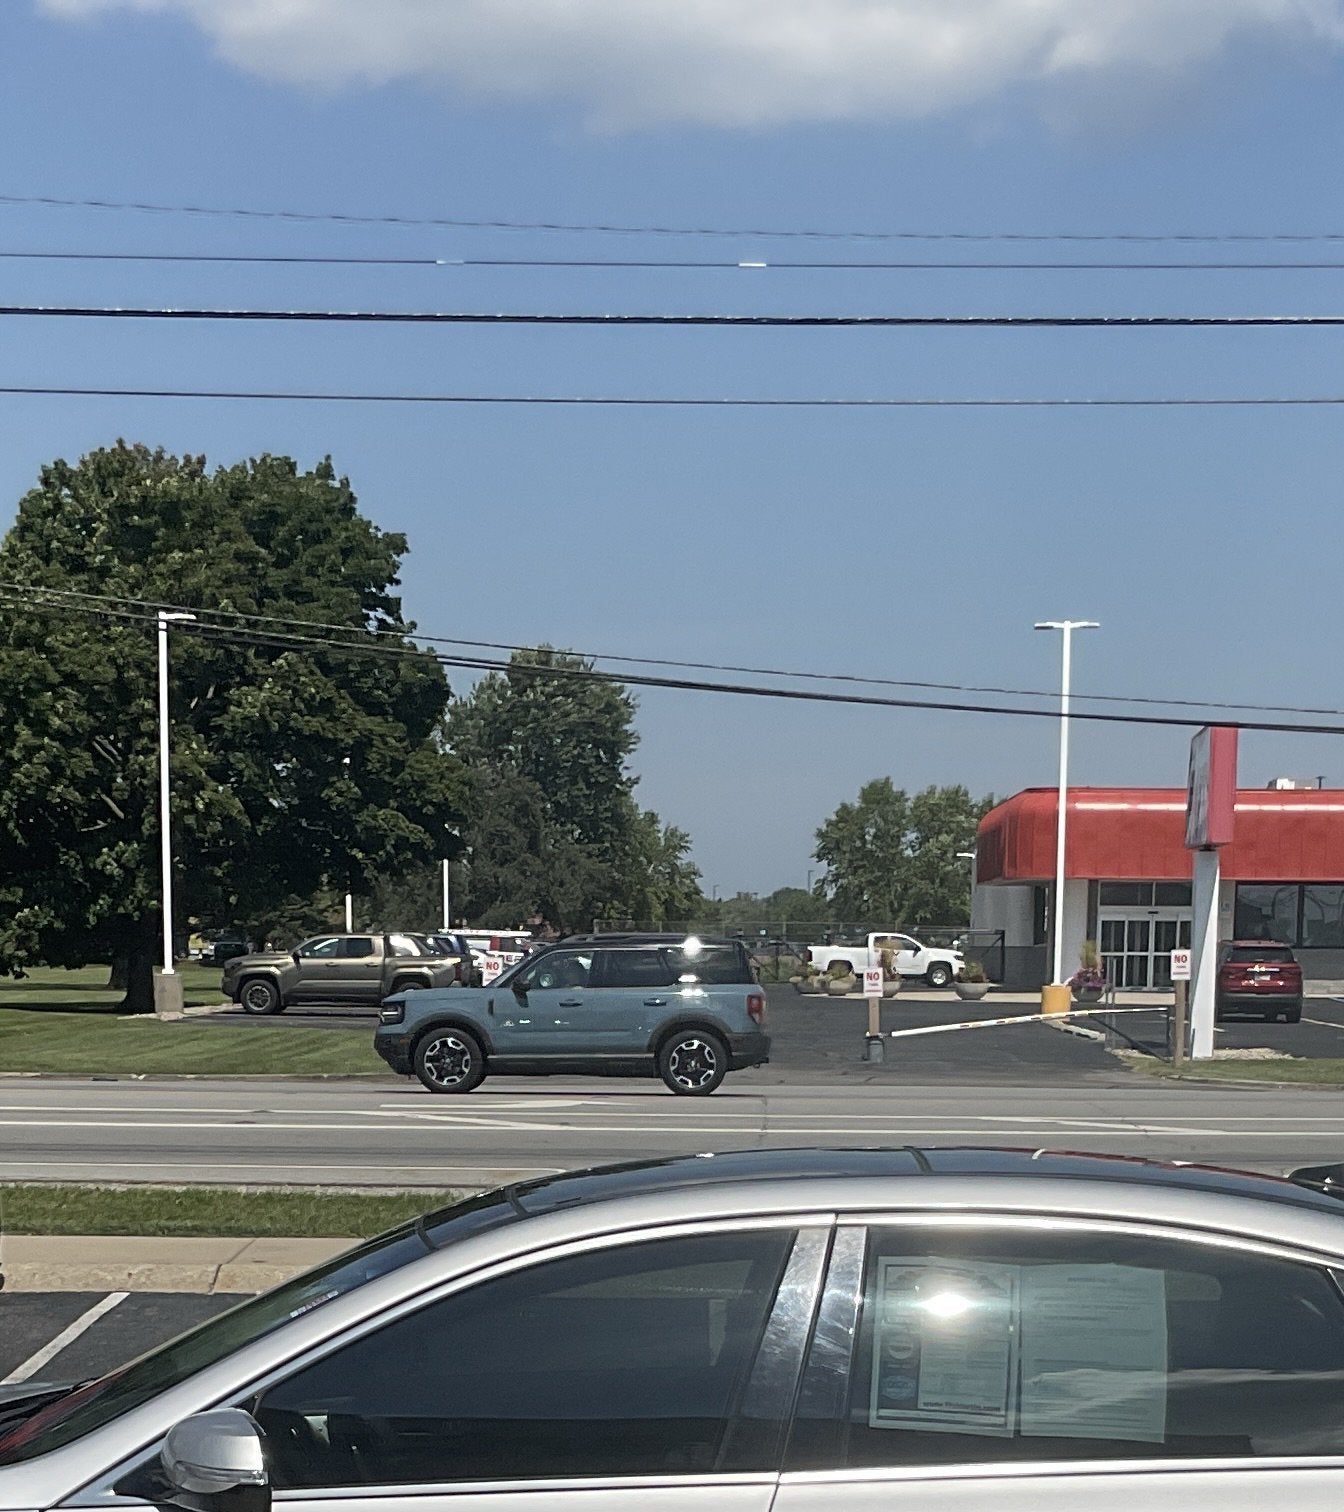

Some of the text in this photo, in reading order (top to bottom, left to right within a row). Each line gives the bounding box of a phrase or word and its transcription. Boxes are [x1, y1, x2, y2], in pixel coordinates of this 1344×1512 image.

[1174, 954, 1188, 964] NO
[486, 961, 500, 970] NO
[866, 971, 880, 981] NO
